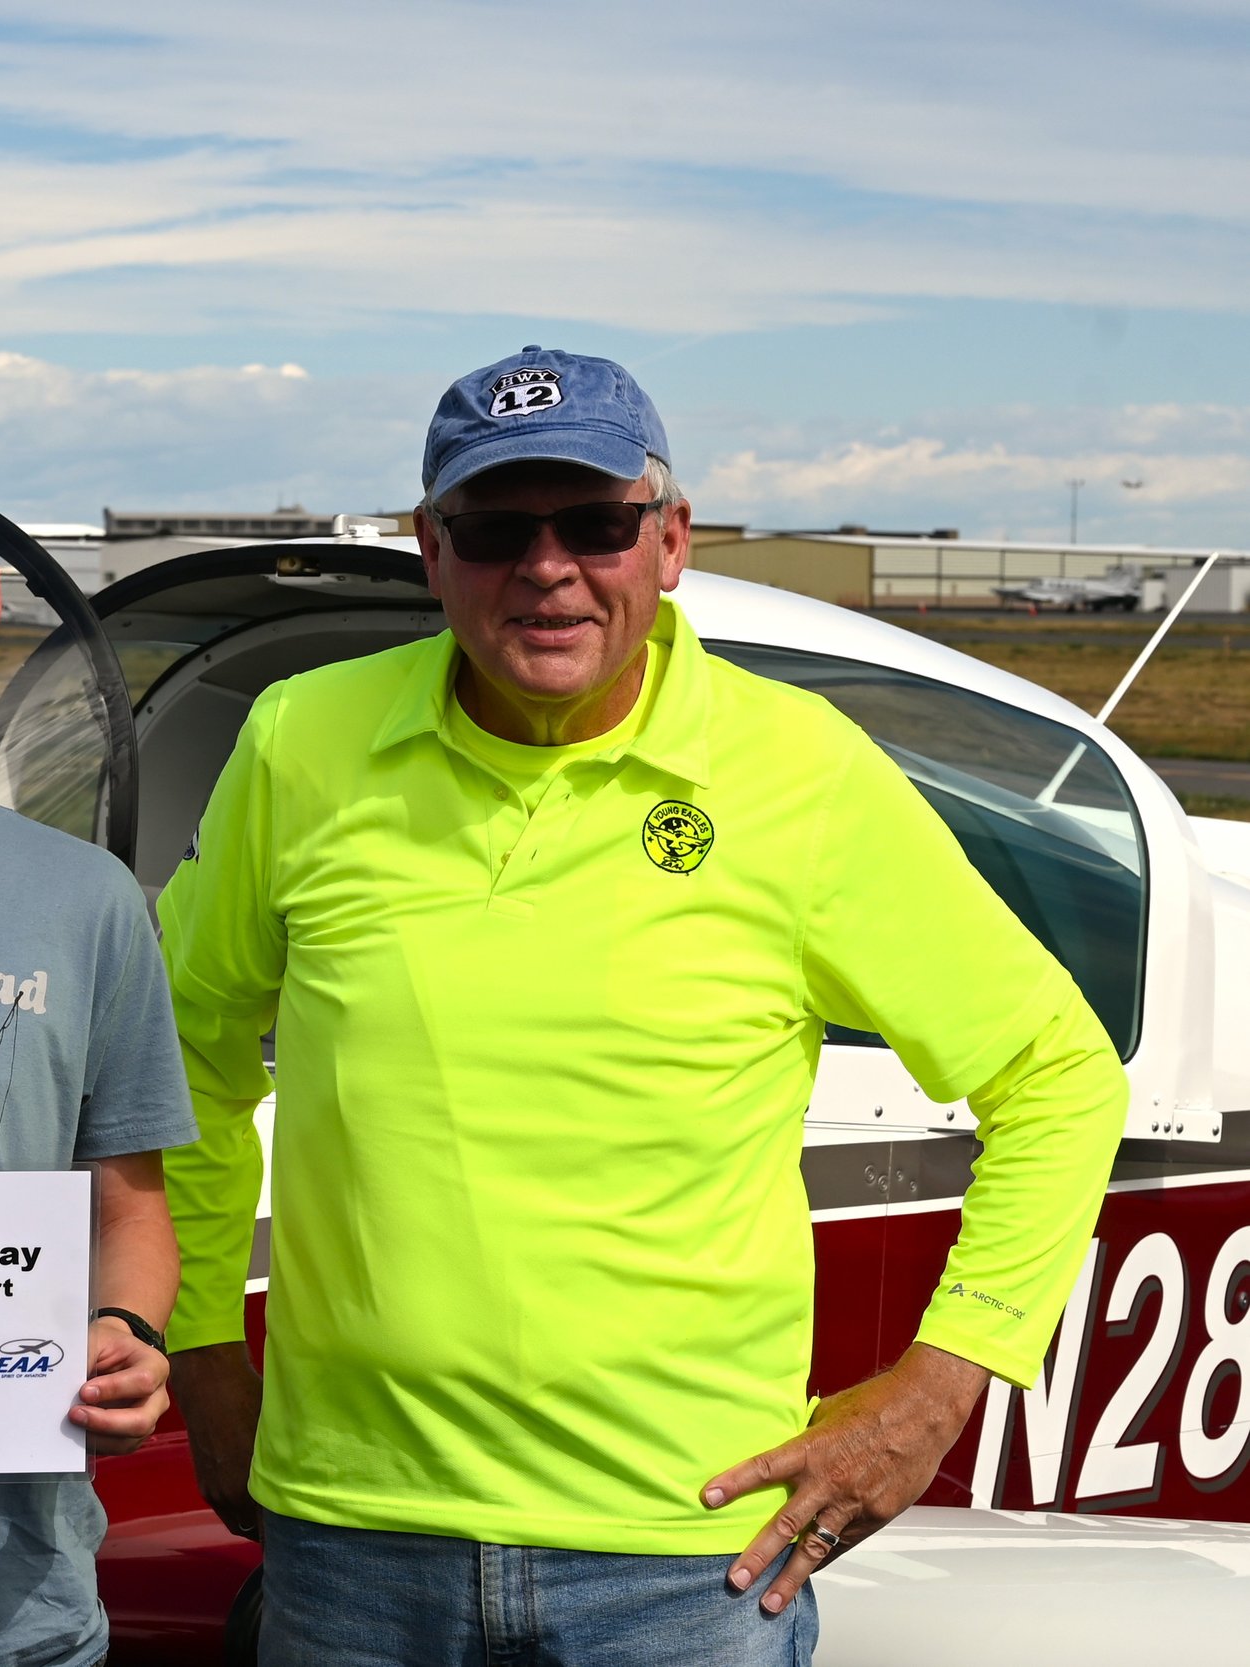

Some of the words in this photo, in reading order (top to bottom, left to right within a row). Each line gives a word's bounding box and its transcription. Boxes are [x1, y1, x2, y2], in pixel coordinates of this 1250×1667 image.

[501, 372, 550, 388] HWY
[498, 386, 553, 414] 12
[653, 806, 679, 822] YOUNG
[681, 808, 709, 834] EAGLES
[971, 1291, 1005, 1310] ARCTIC
